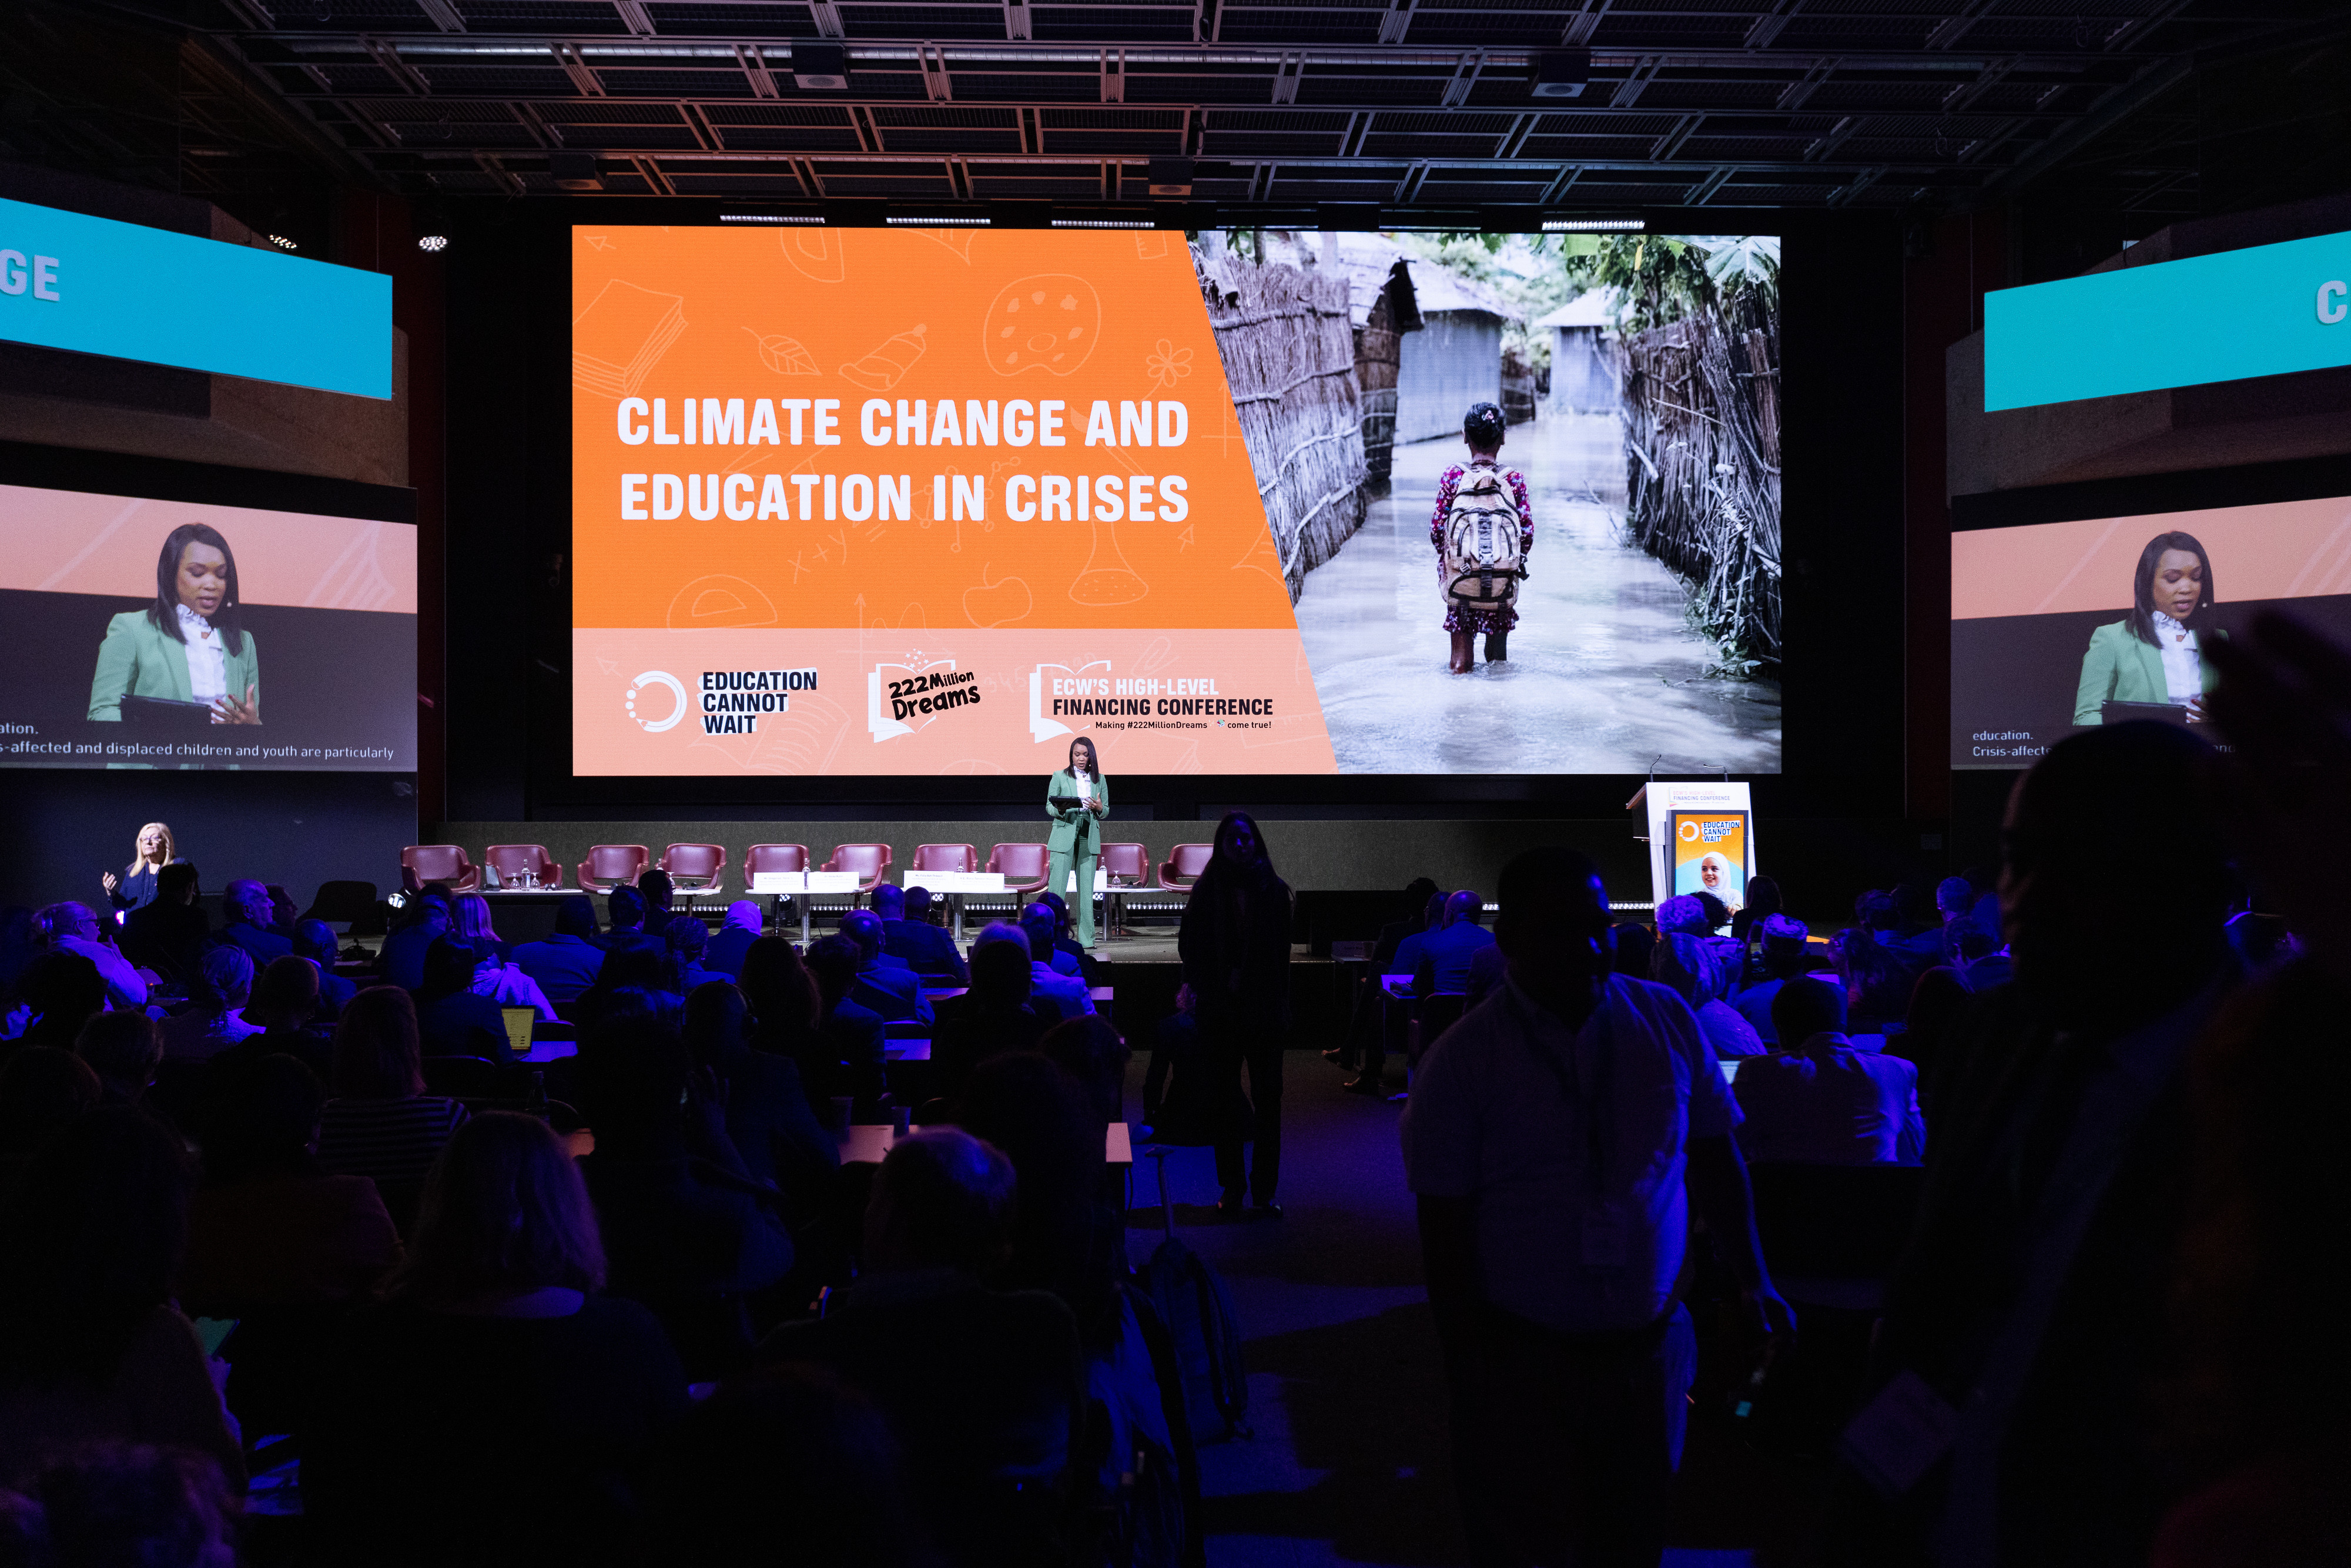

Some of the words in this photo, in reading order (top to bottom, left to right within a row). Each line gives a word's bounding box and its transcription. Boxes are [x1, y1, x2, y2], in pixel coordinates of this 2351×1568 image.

[617, 397, 841, 447] CLIMATE
[860, 398, 1066, 447] CHANGE
[1084, 400, 1188, 448] AND
[621, 473, 911, 521] EDUCATION
[933, 474, 984, 522] IN
[1005, 474, 1189, 522] CRISES
[702, 671, 817, 691] EDUCATION
[888, 671, 974, 699] 222Million
[1116, 678, 1220, 696] HIGH-LEVEL
[704, 693, 788, 712] CANNOT
[892, 685, 981, 721] Dreams
[1053, 699, 1151, 716] FINANCING
[1157, 698, 1273, 716] CONFERENCE
[704, 715, 756, 734] WAIT
[1096, 721, 1125, 731] Making
[1127, 721, 1208, 729] #222MillionDreams
[1972, 730, 2034, 741] education.
[75, 742, 102, 755] and
[106, 742, 172, 758] displaced
[176, 743, 232, 756] children
[235, 745, 259, 756] and
[262, 745, 297, 759] youth
[300, 748, 321, 758] are
[324, 746, 394, 761] particularly
